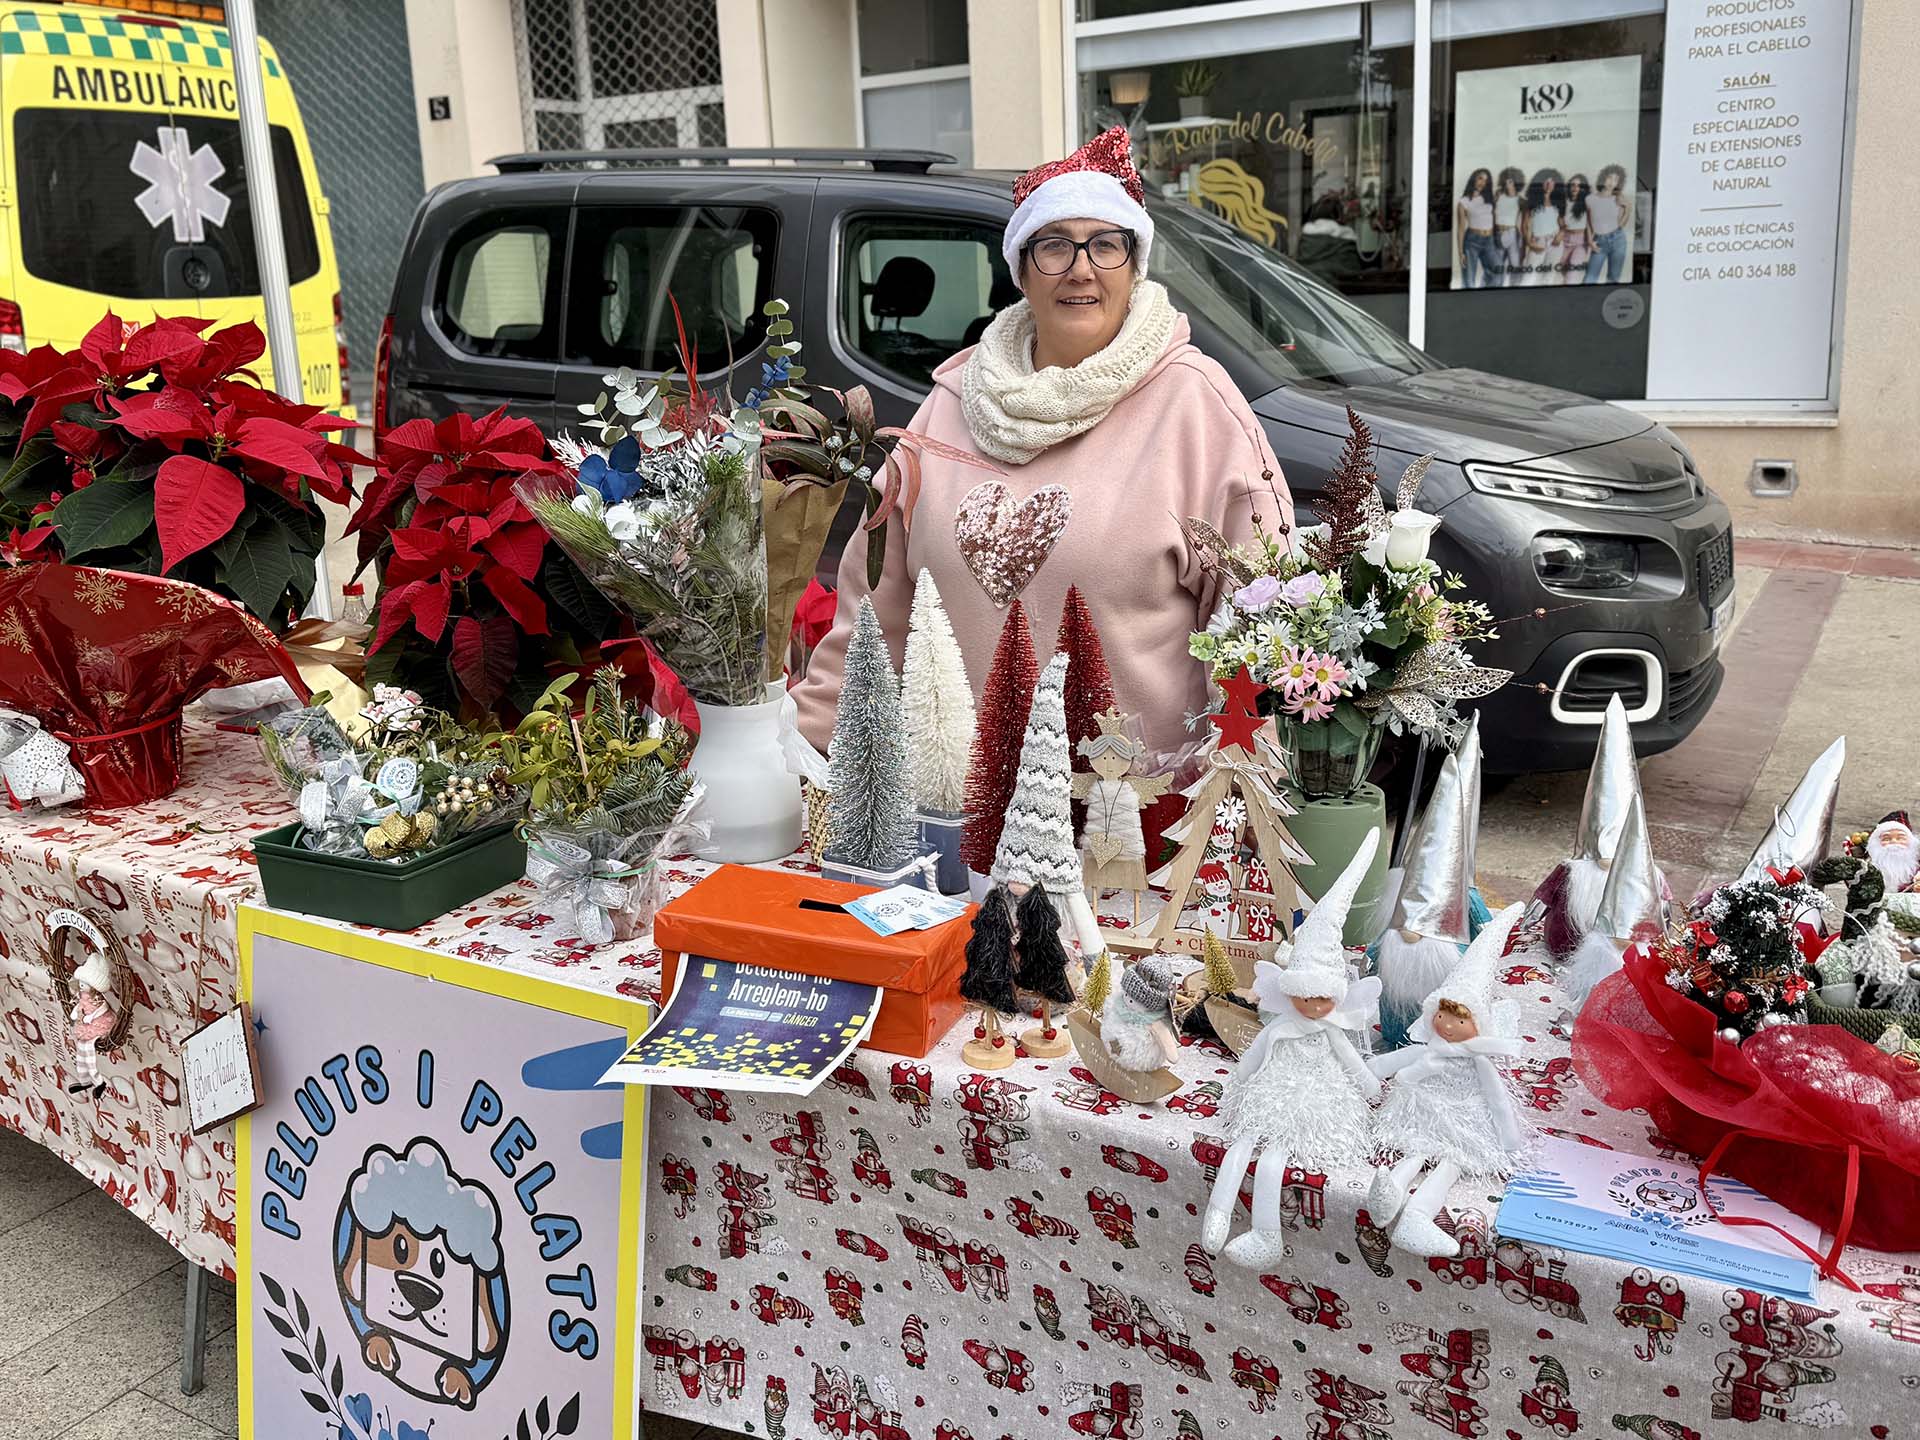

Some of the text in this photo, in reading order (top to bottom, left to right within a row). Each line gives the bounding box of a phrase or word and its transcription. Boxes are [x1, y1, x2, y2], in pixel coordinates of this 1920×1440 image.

[1706, 0, 1796, 18] PRODUCTOS
[1694, 15, 1807, 39] PROFESIONALES
[1688, 35, 1811, 60] PARA EL CABELLO
[52, 65, 237, 112] AMBULÀNC
[1723, 72, 1771, 89] SALÓN
[432, 97, 446, 119] 5
[1717, 96, 1776, 114] CENTRO
[1228, 111, 1261, 143] del
[1692, 114, 1800, 135] ESPECIALIZADO
[1518, 131, 1573, 142] CURLY HAIR
[1688, 134, 1803, 154] EN EXTENSIONES
[1702, 155, 1787, 173] DE CABELLO
[1713, 176, 1772, 191] NATURAL
[1690, 219, 1795, 237] VARIAS TÉCNICAS
[1687, 237, 1795, 254] DE COLOCACIÓN
[1536, 262, 1552, 273] del
[1682, 263, 1797, 280] CITA 640 364 188
[53, 912, 97, 941] WELCOME
[727, 978, 829, 1012] Arreglem-ho
[152, 1102, 167, 1157] CHRISTMAS
[1609, 1167, 1662, 1188] PELUTS
[261, 1045, 600, 1362] PELUTS I PELATS
[1603, 1219, 1649, 1236] ANNA
